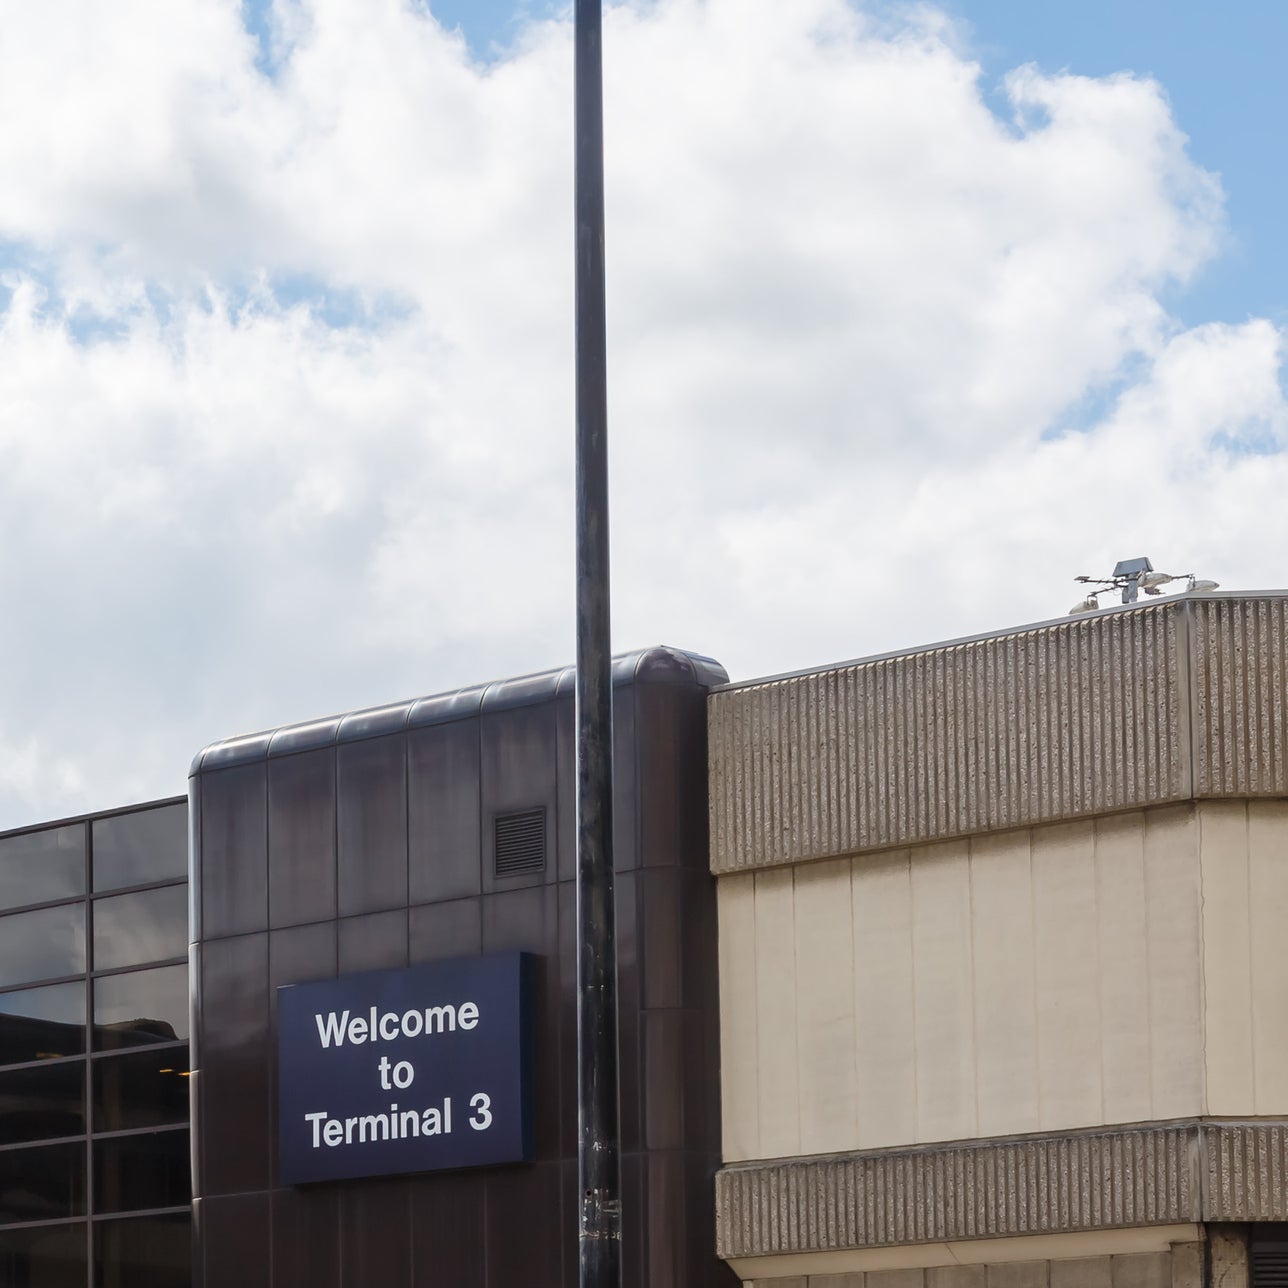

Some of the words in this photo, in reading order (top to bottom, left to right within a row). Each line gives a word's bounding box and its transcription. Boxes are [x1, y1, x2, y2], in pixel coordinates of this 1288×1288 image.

[315, 1002, 479, 1048] Welcome
[378, 1056, 414, 1090] to
[305, 1097, 451, 1148] Terminal
[469, 1092, 493, 1130] 3
